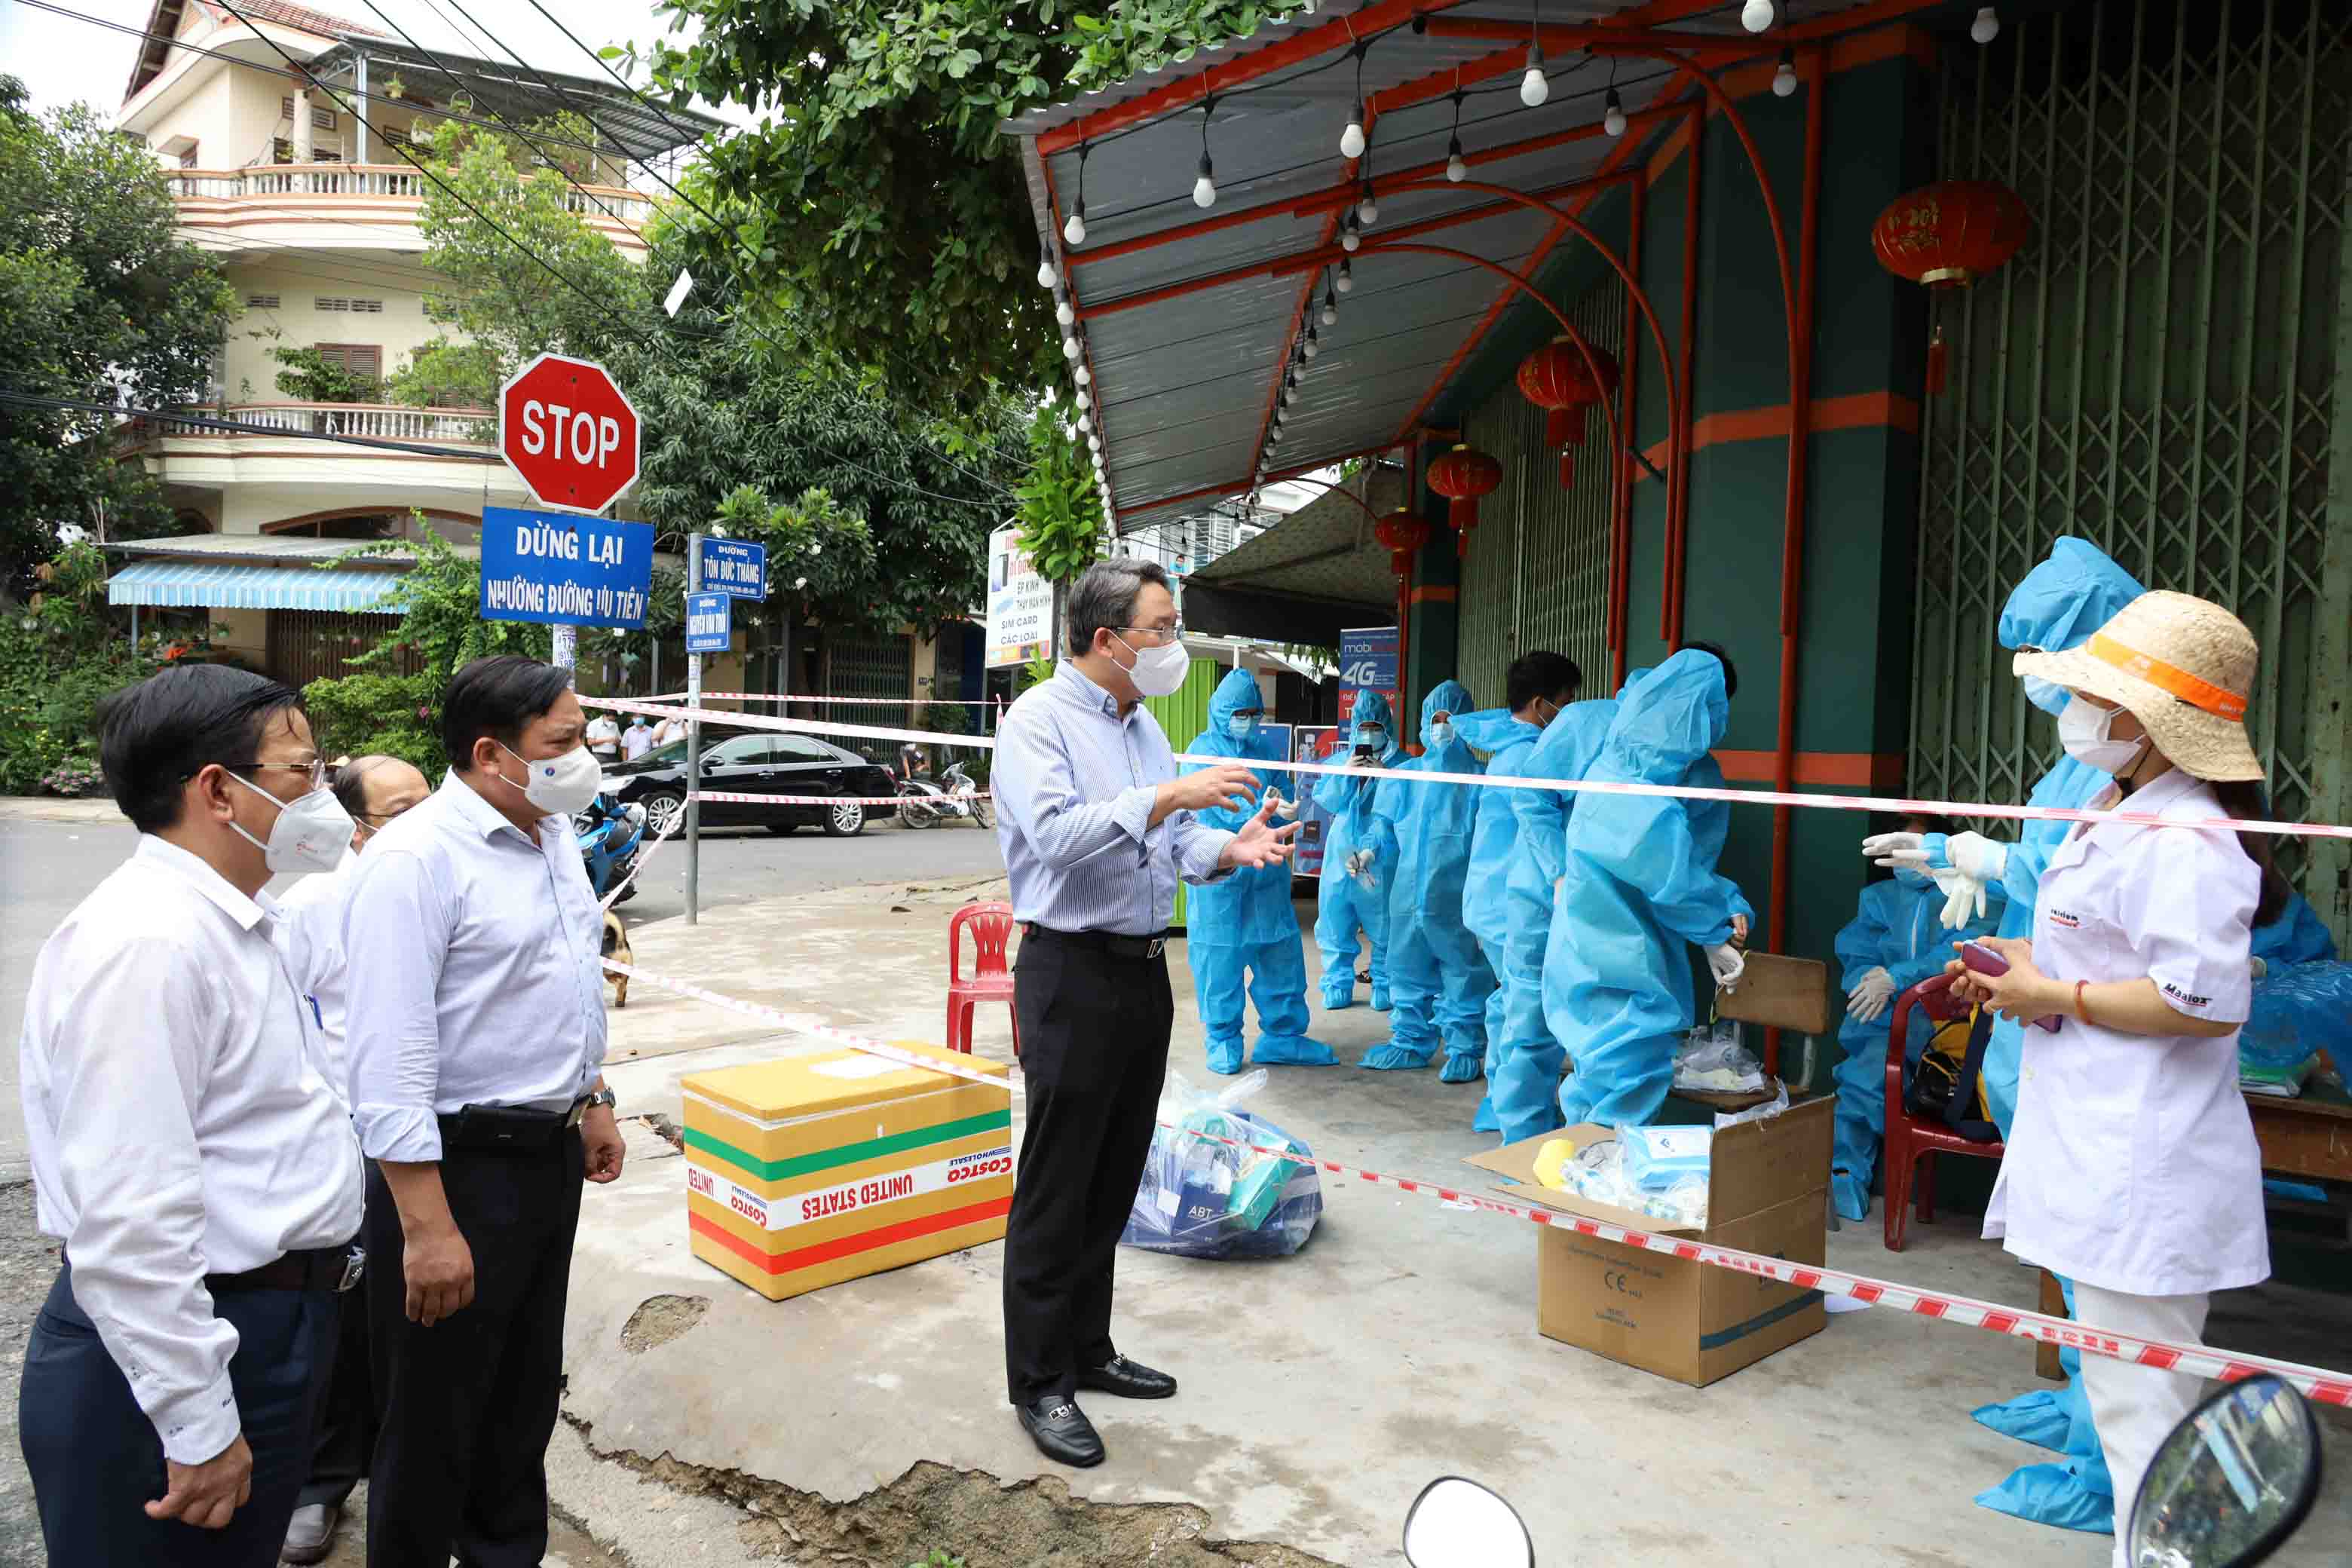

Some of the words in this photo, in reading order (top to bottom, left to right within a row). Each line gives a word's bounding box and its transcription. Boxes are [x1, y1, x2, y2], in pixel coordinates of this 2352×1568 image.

[522, 399, 620, 469] STOP
[516, 520, 579, 561] DỪNG
[588, 534, 623, 569] LẠI
[487, 574, 544, 613] NHƯỜNG
[547, 578, 593, 617] ĐƯỜNG
[616, 586, 644, 620] TIÊN
[1001, 620, 1015, 629] SIM
[1016, 614, 1038, 627] CARD
[1341, 661, 1377, 686] 4G
[2164, 982, 2213, 1003] Maalox
[948, 1156, 1012, 1183] COSTCO
[949, 1150, 996, 1166] WHOLESALE
[688, 1168, 714, 1199] UNITED
[861, 1174, 913, 1204] UNITED
[730, 1195, 767, 1229] COSTCO
[802, 1187, 856, 1220] STATES
[1189, 1205, 1213, 1218] ABT
